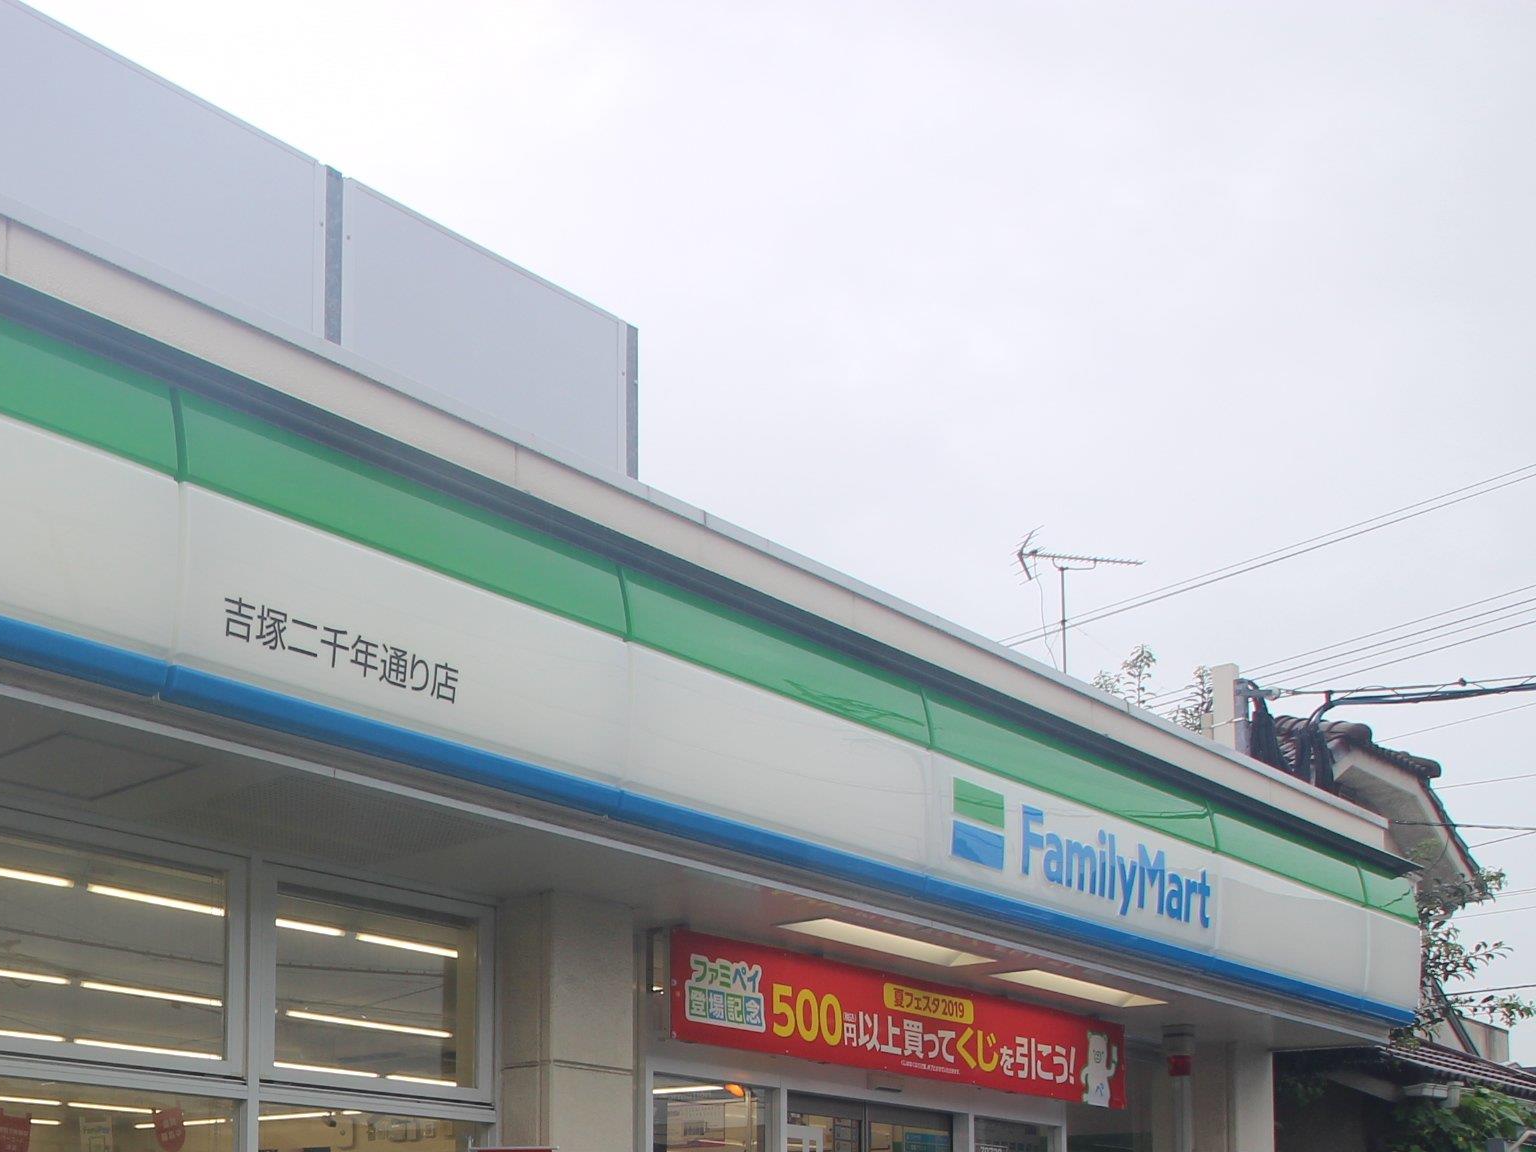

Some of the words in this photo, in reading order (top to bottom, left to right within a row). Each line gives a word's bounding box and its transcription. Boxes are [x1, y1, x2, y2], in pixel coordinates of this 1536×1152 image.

[224, 597, 459, 704] 吉塚二千年通り店
[1021, 803, 1211, 928] FamilyMart
[690, 987, 762, 1026] 登場記念
[693, 957, 760, 993] ファミペイ
